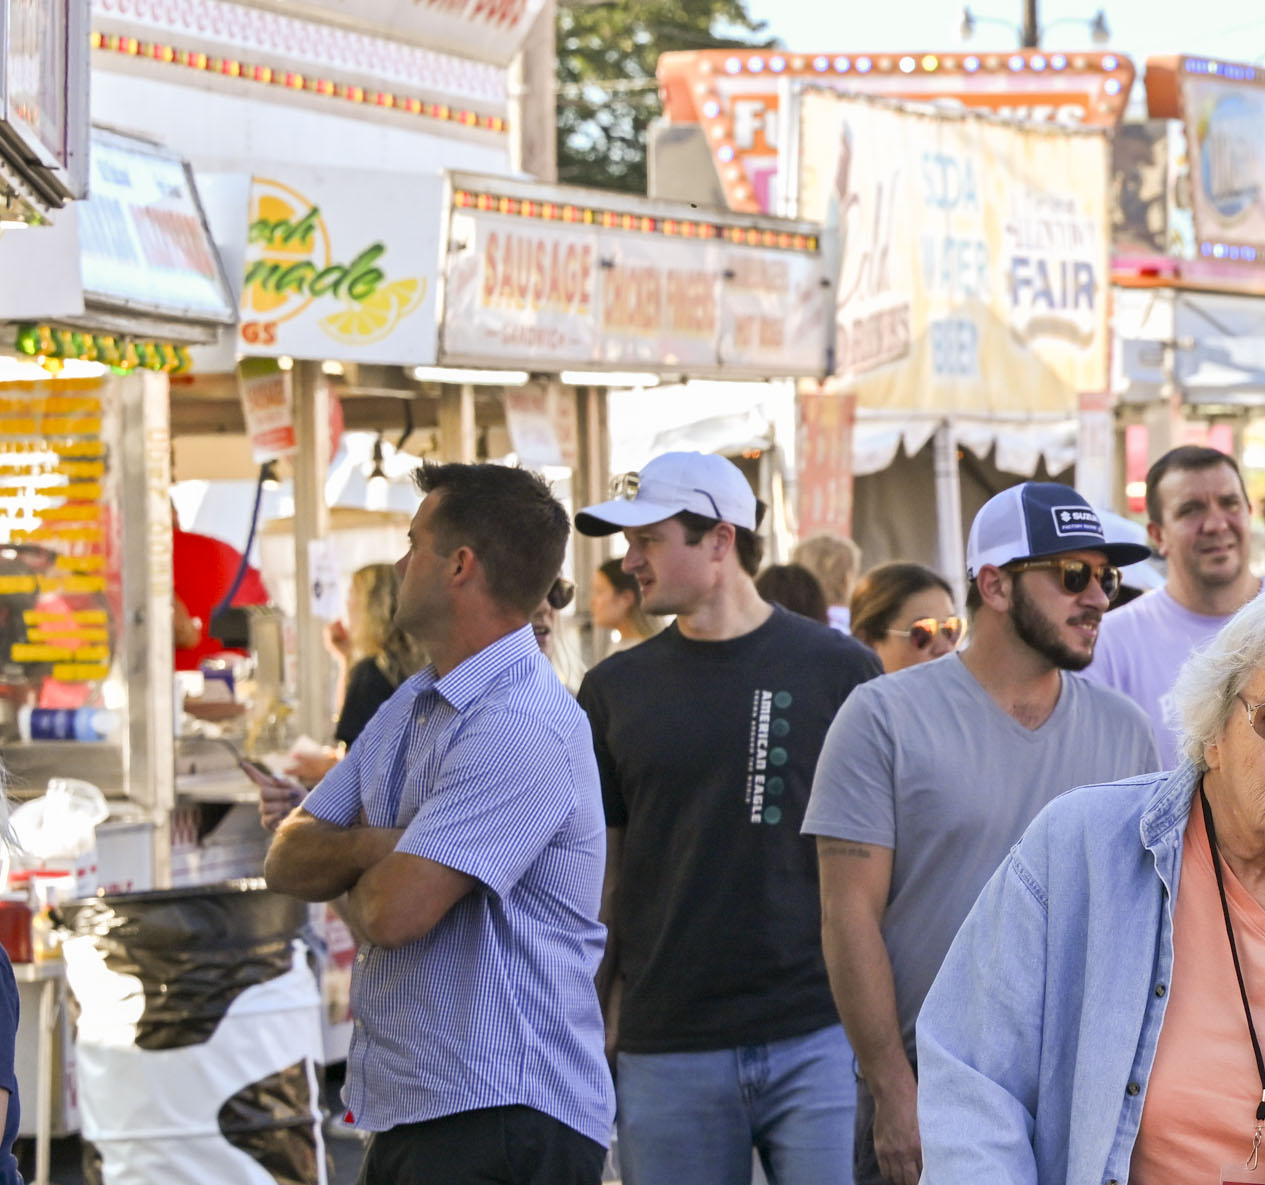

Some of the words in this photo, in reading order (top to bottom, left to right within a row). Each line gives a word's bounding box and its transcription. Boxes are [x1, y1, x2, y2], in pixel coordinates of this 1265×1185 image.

[483, 231, 592, 313] SAUSAGE
[1009, 256, 1096, 311] FAIR
[755, 689, 773, 770] AMERICAN
[751, 774, 765, 824] EAGLE
